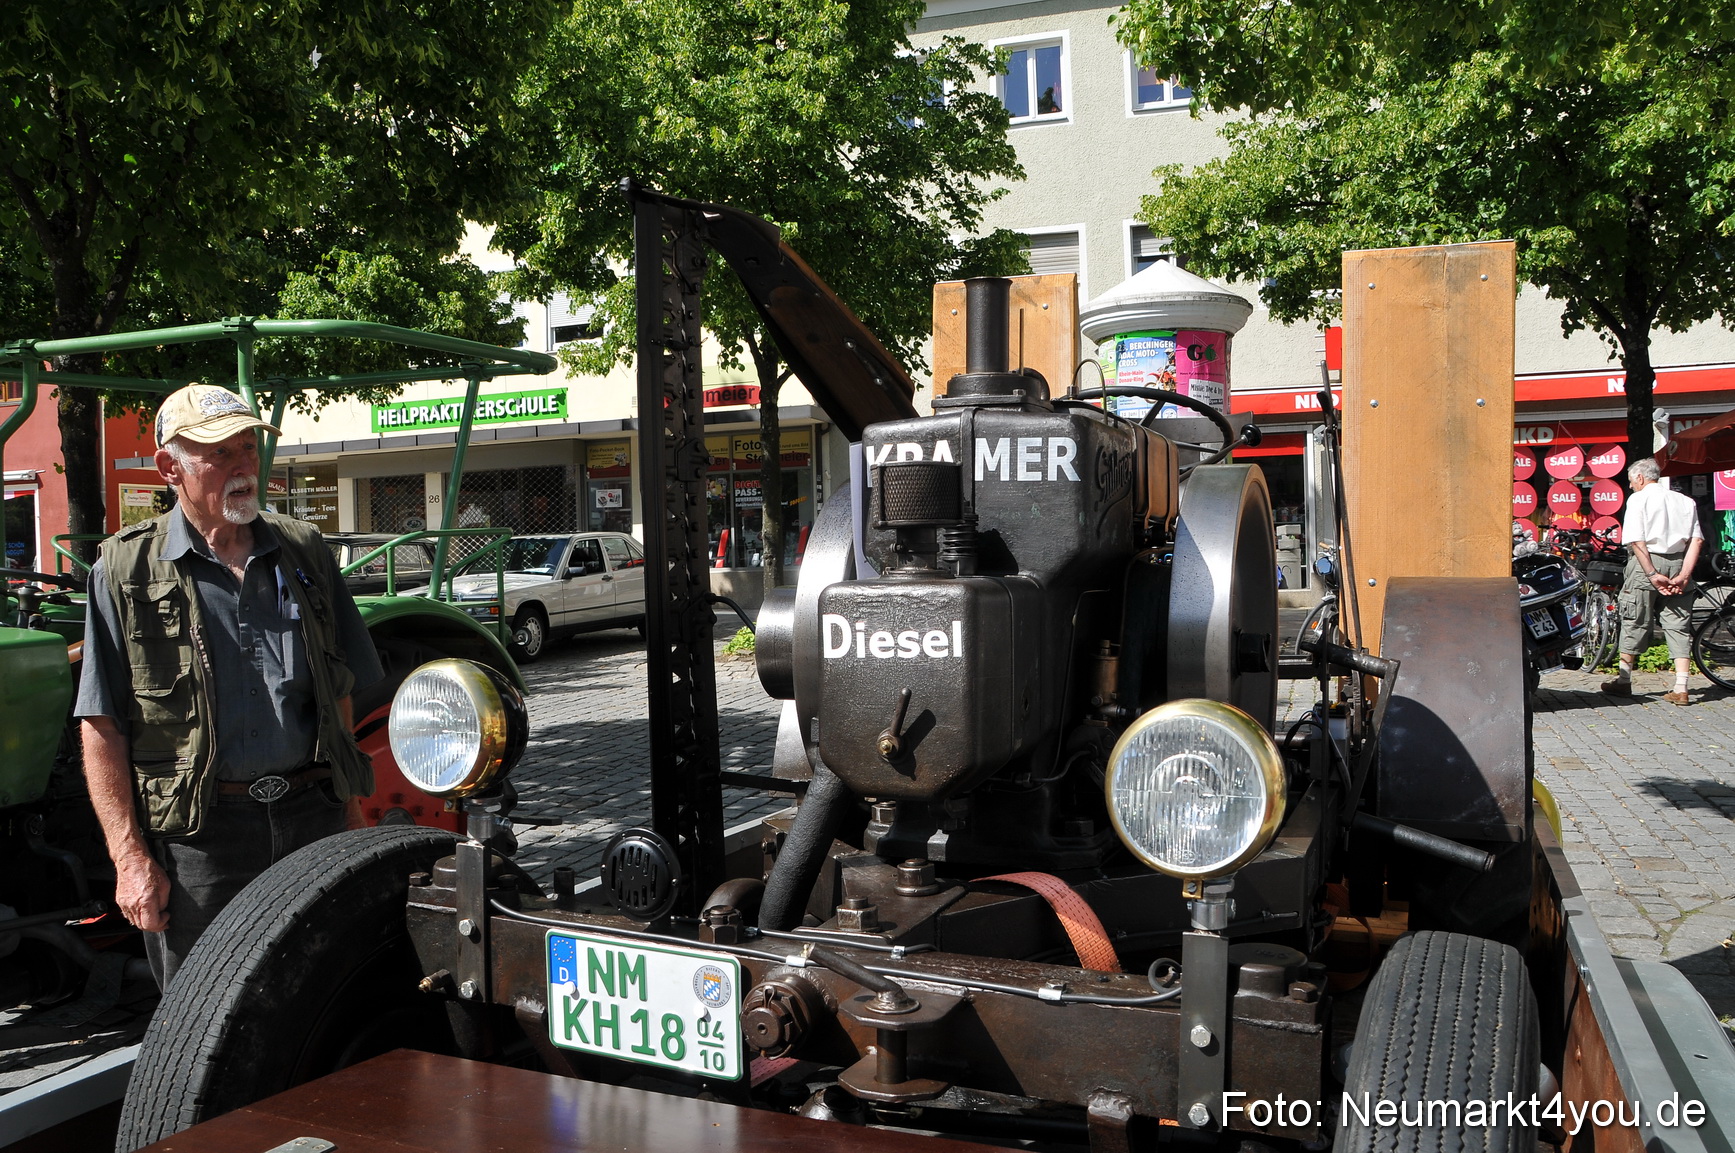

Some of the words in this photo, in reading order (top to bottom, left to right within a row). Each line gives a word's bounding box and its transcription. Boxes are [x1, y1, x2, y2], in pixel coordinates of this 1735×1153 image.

[1129, 340, 1174, 351] BERCHINGER
[1119, 351, 1135, 360] ADAC
[1136, 350, 1159, 358] MOTO-
[1187, 344, 1217, 361] G6
[1118, 359, 1138, 367] CROSS
[706, 386, 756, 402] meier
[378, 395, 557, 425] HEILPRAKTIERSCHULE
[735, 440, 762, 451] Foto
[1514, 458, 1531, 467] ALE
[1550, 456, 1577, 466] SALE
[1592, 455, 1619, 465] SALE
[735, 480, 761, 488] DIGIT
[735, 489, 761, 497] PASS-
[1552, 493, 1576, 502] SALE
[1594, 492, 1618, 501] SALE
[428, 495, 440, 503] 26
[1529, 609, 1545, 623] NM
[1542, 620, 1556, 632] 43
[822, 613, 963, 659] Diesel
[559, 967, 570, 982] D
[587, 947, 648, 1001] NM
[697, 1017, 725, 1040] 04
[699, 1049, 725, 1071] 10
